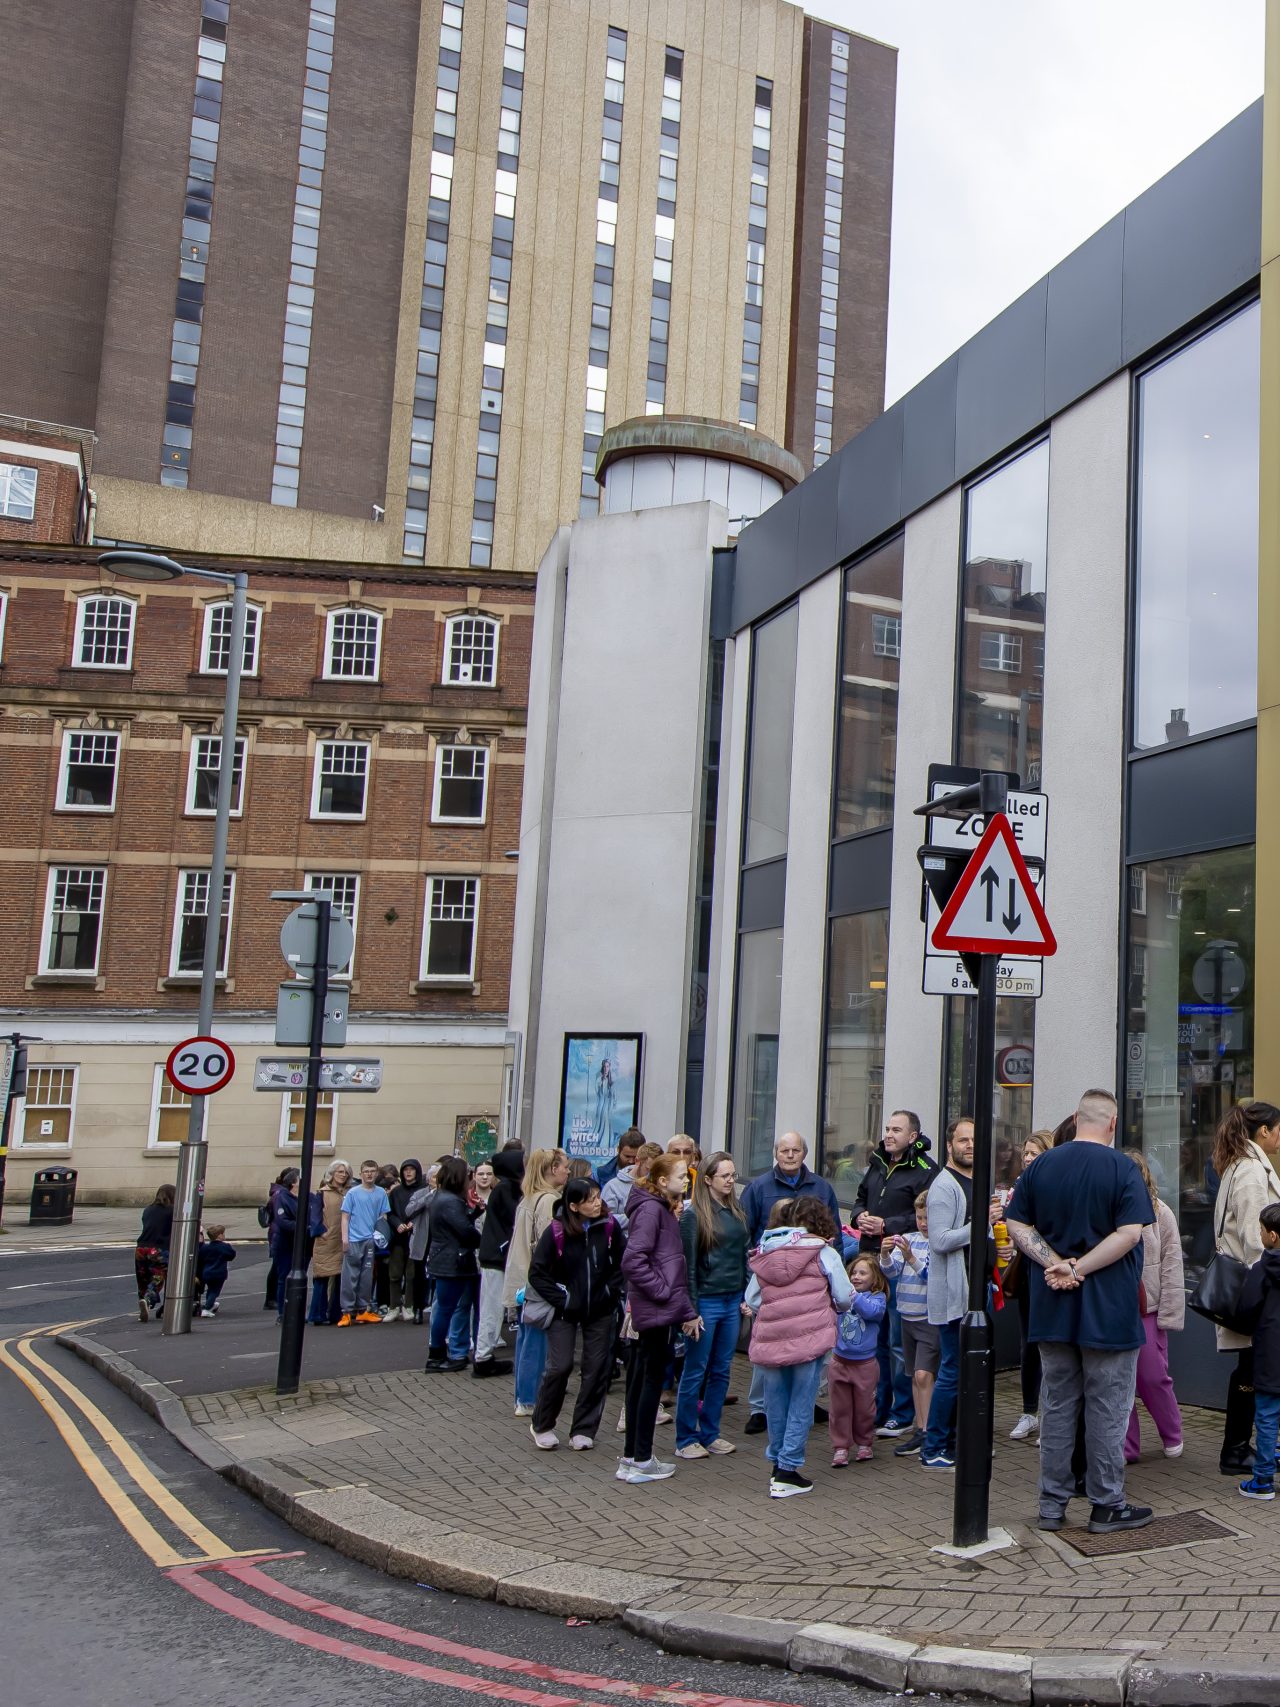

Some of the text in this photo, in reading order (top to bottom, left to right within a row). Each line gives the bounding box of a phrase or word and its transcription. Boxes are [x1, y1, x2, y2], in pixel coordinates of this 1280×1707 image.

[955, 814, 1024, 841] ZOE
[951, 977, 959, 988] 8
[1015, 981, 1033, 991] pm
[178, 1053, 226, 1077] 20
[572, 1118, 593, 1128] LION
[571, 1132, 599, 1142] WITCH
